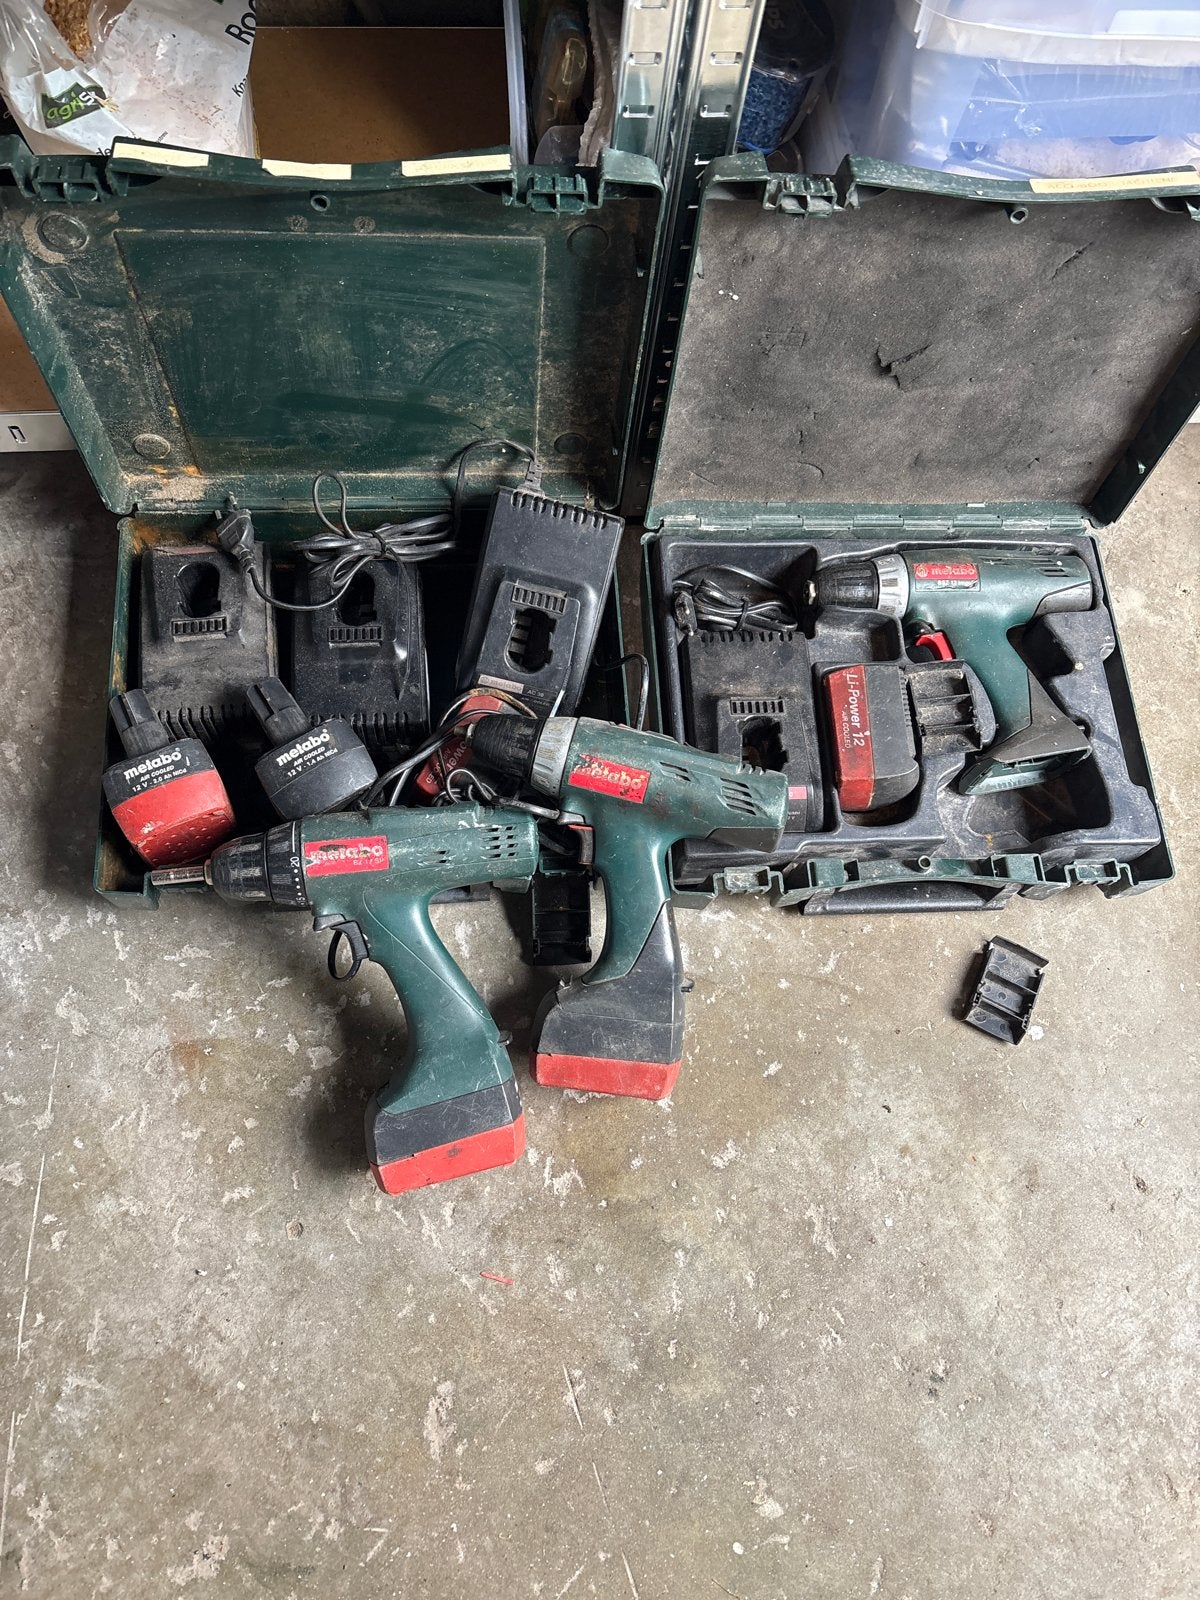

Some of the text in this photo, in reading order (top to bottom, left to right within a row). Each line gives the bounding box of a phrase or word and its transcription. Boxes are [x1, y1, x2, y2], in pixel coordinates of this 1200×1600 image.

[931, 565, 975, 576] metabo
[846, 673, 865, 747] Li-Power 12
[842, 722, 851, 749] COOLED
[276, 732, 330, 767] metabo
[293, 746, 326, 767] AIR COOLED
[446, 741, 467, 771] ower
[123, 751, 182, 780] metabo
[140, 765, 175, 782] AIR COOLED
[287, 769, 297, 777] 12
[316, 754, 325, 762] Ah
[573, 764, 642, 790] metabo
[132, 784, 142, 793] 12
[163, 773, 173, 781] Ah
[289, 856, 300, 868] 20
